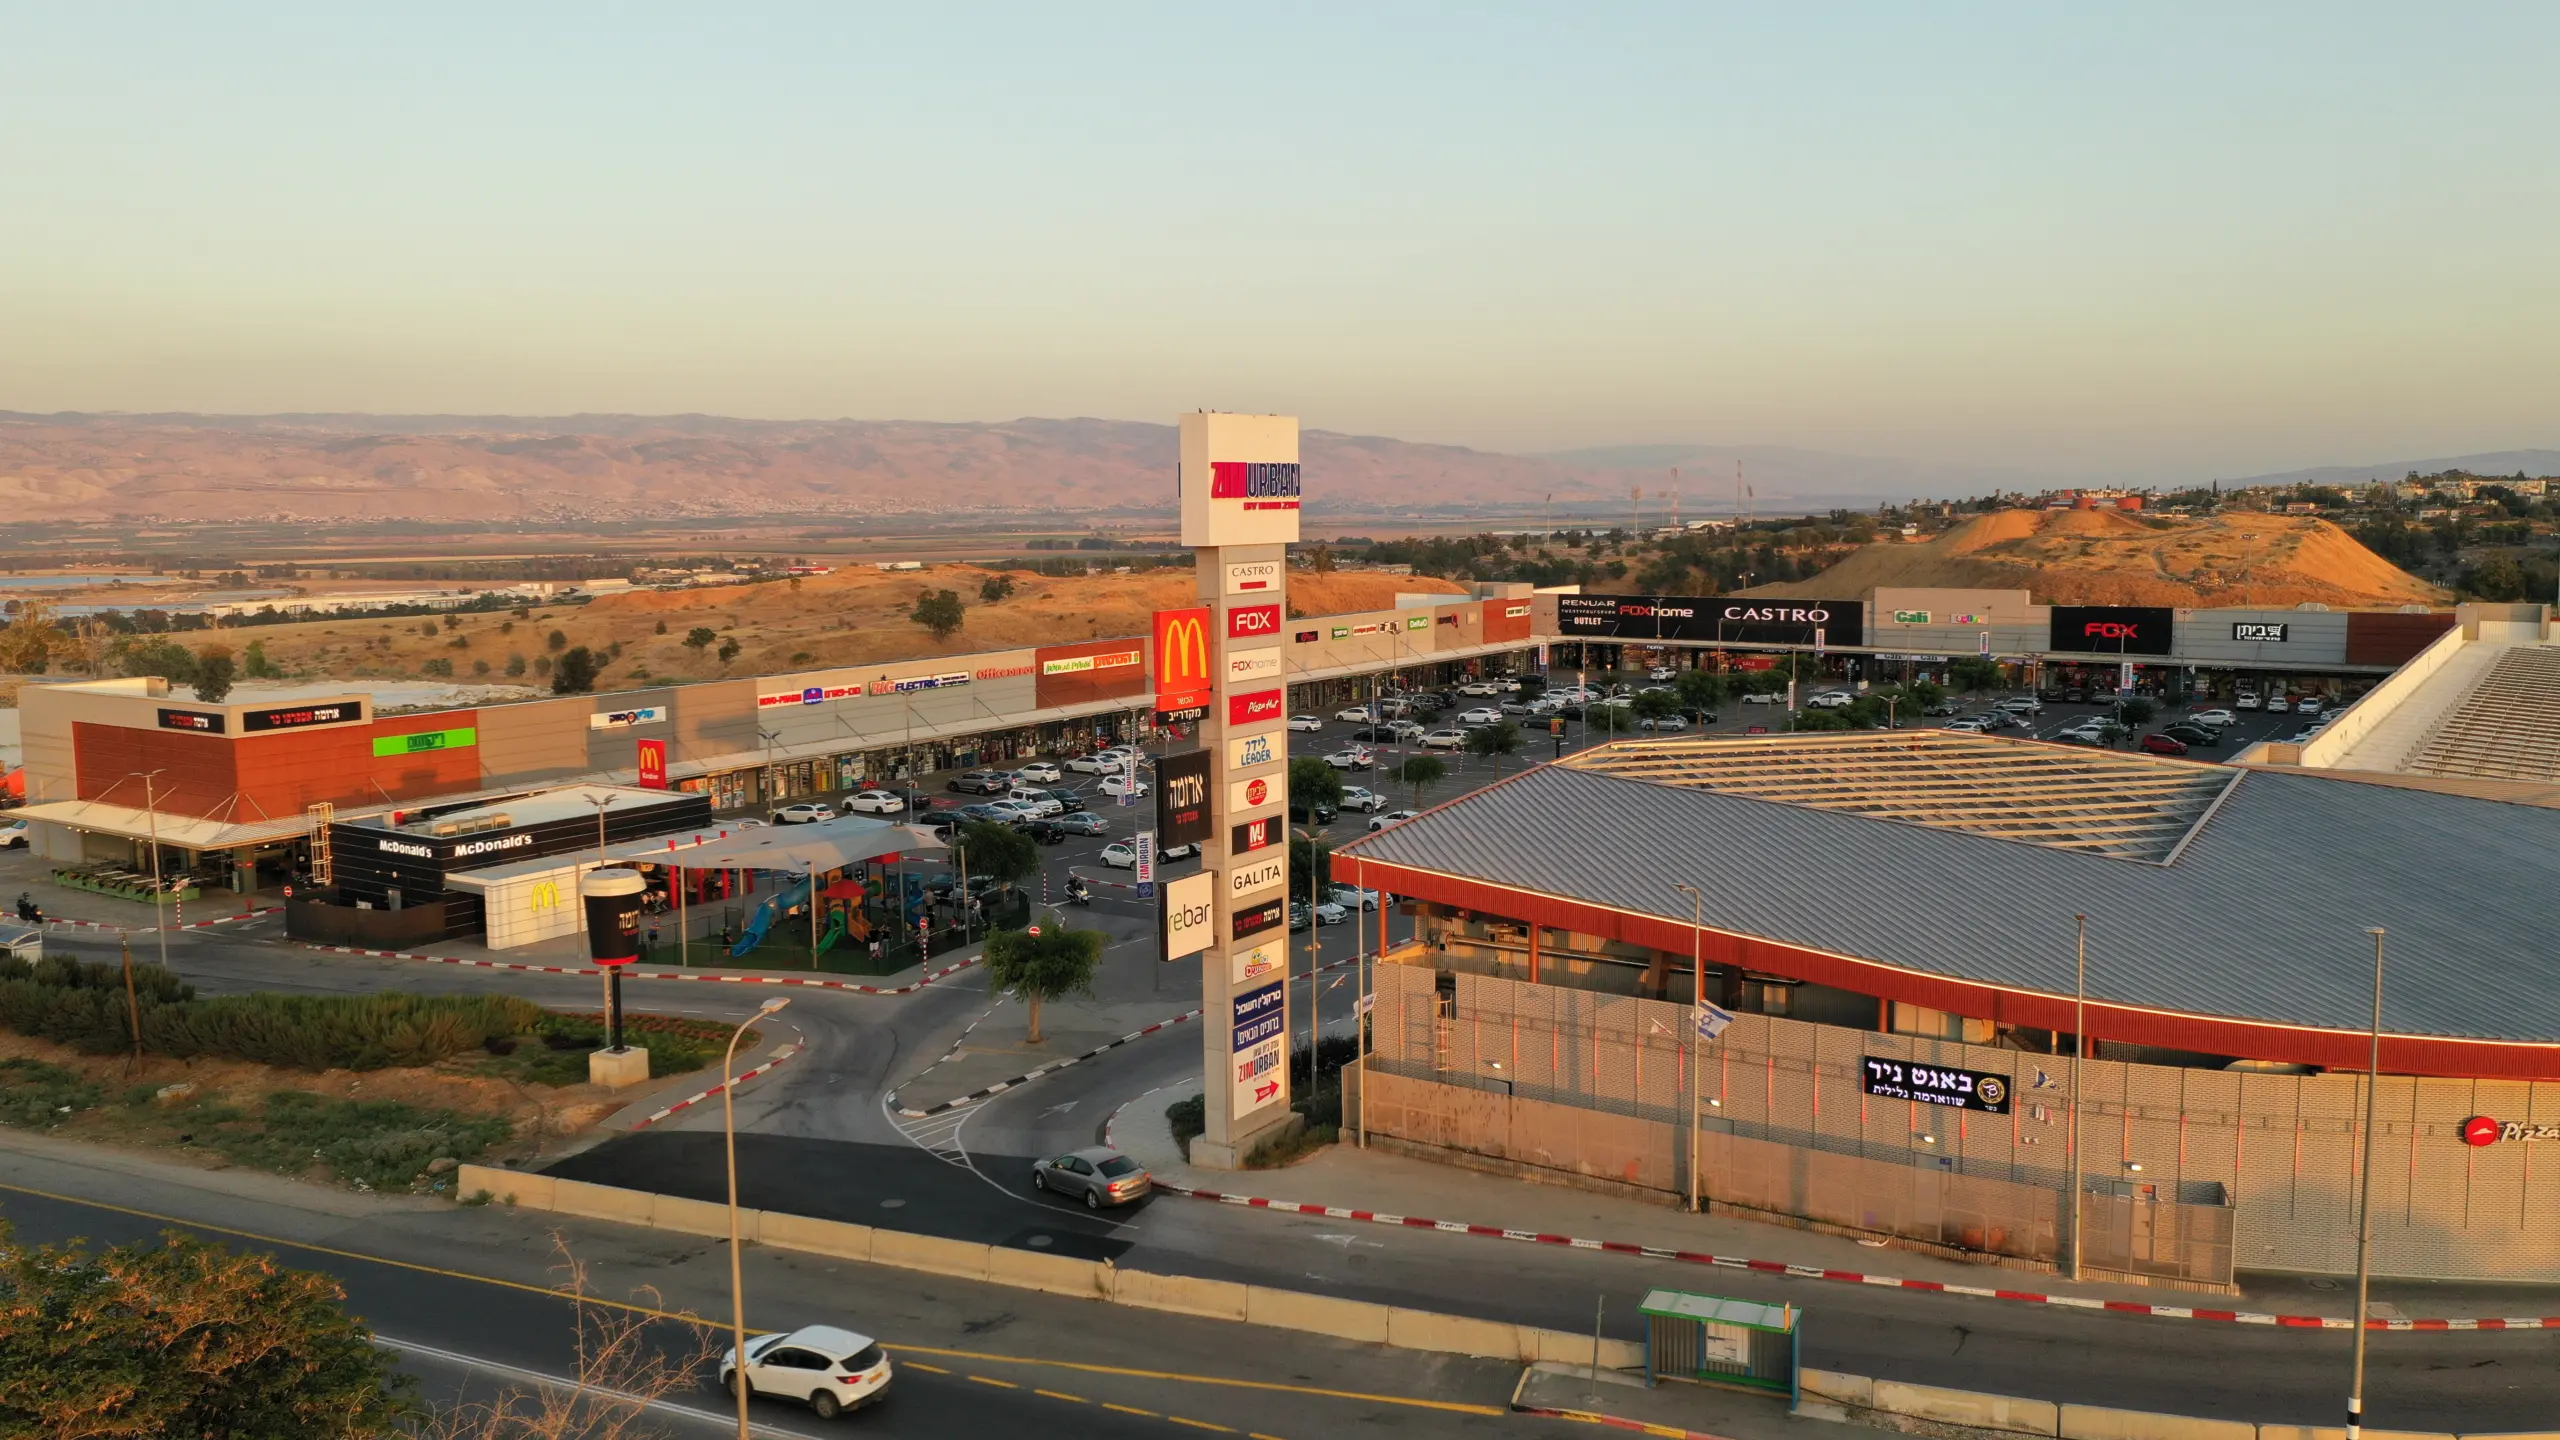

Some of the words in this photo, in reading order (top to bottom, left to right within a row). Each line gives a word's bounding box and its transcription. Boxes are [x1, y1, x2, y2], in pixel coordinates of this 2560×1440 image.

[1232, 565, 1274, 577] CASTRO
[1620, 605, 1694, 618] FOXhome
[1724, 606, 1829, 622] CASTRO
[1236, 611, 1272, 631] FOX
[1574, 617, 1602, 626] OUTLET
[2084, 622, 2138, 638] FOX
[2236, 624, 2266, 640] ביתן
[1231, 658, 1278, 672] FOXhome
[872, 680, 896, 694] BIG
[896, 676, 940, 691] ELECTRIC
[314, 708, 340, 720] ארומה
[1168, 708, 1202, 722] מקדרייב
[1247, 702, 1265, 714] Pizza
[1266, 699, 1280, 710] Hut
[1245, 734, 1266, 753] לידר
[1241, 749, 1272, 766] LEADER
[1170, 773, 1204, 810] ארומה
[1250, 822, 1264, 843] MJ
[379, 839, 432, 858] McDonald's
[454, 834, 533, 857] McDonald's
[1139, 838, 1150, 880] ZIMURBAN
[1233, 864, 1280, 890] GALITA
[1168, 903, 1210, 934] rebar
[1264, 906, 1280, 922] ארומה
[1236, 998, 1258, 1016] חשמל
[1237, 1024, 1258, 1046] הבאים!
[1260, 1016, 1280, 1036] ברוכים
[1238, 1048, 1280, 1083] ZIMURBAN
[1868, 1060, 1902, 1082] ניר
[1912, 1066, 1973, 1092] באגט
[1872, 1084, 1909, 1098] גלילית
[1914, 1090, 1966, 1107] שווארמה
[2501, 1121, 2560, 1143] Pizza
